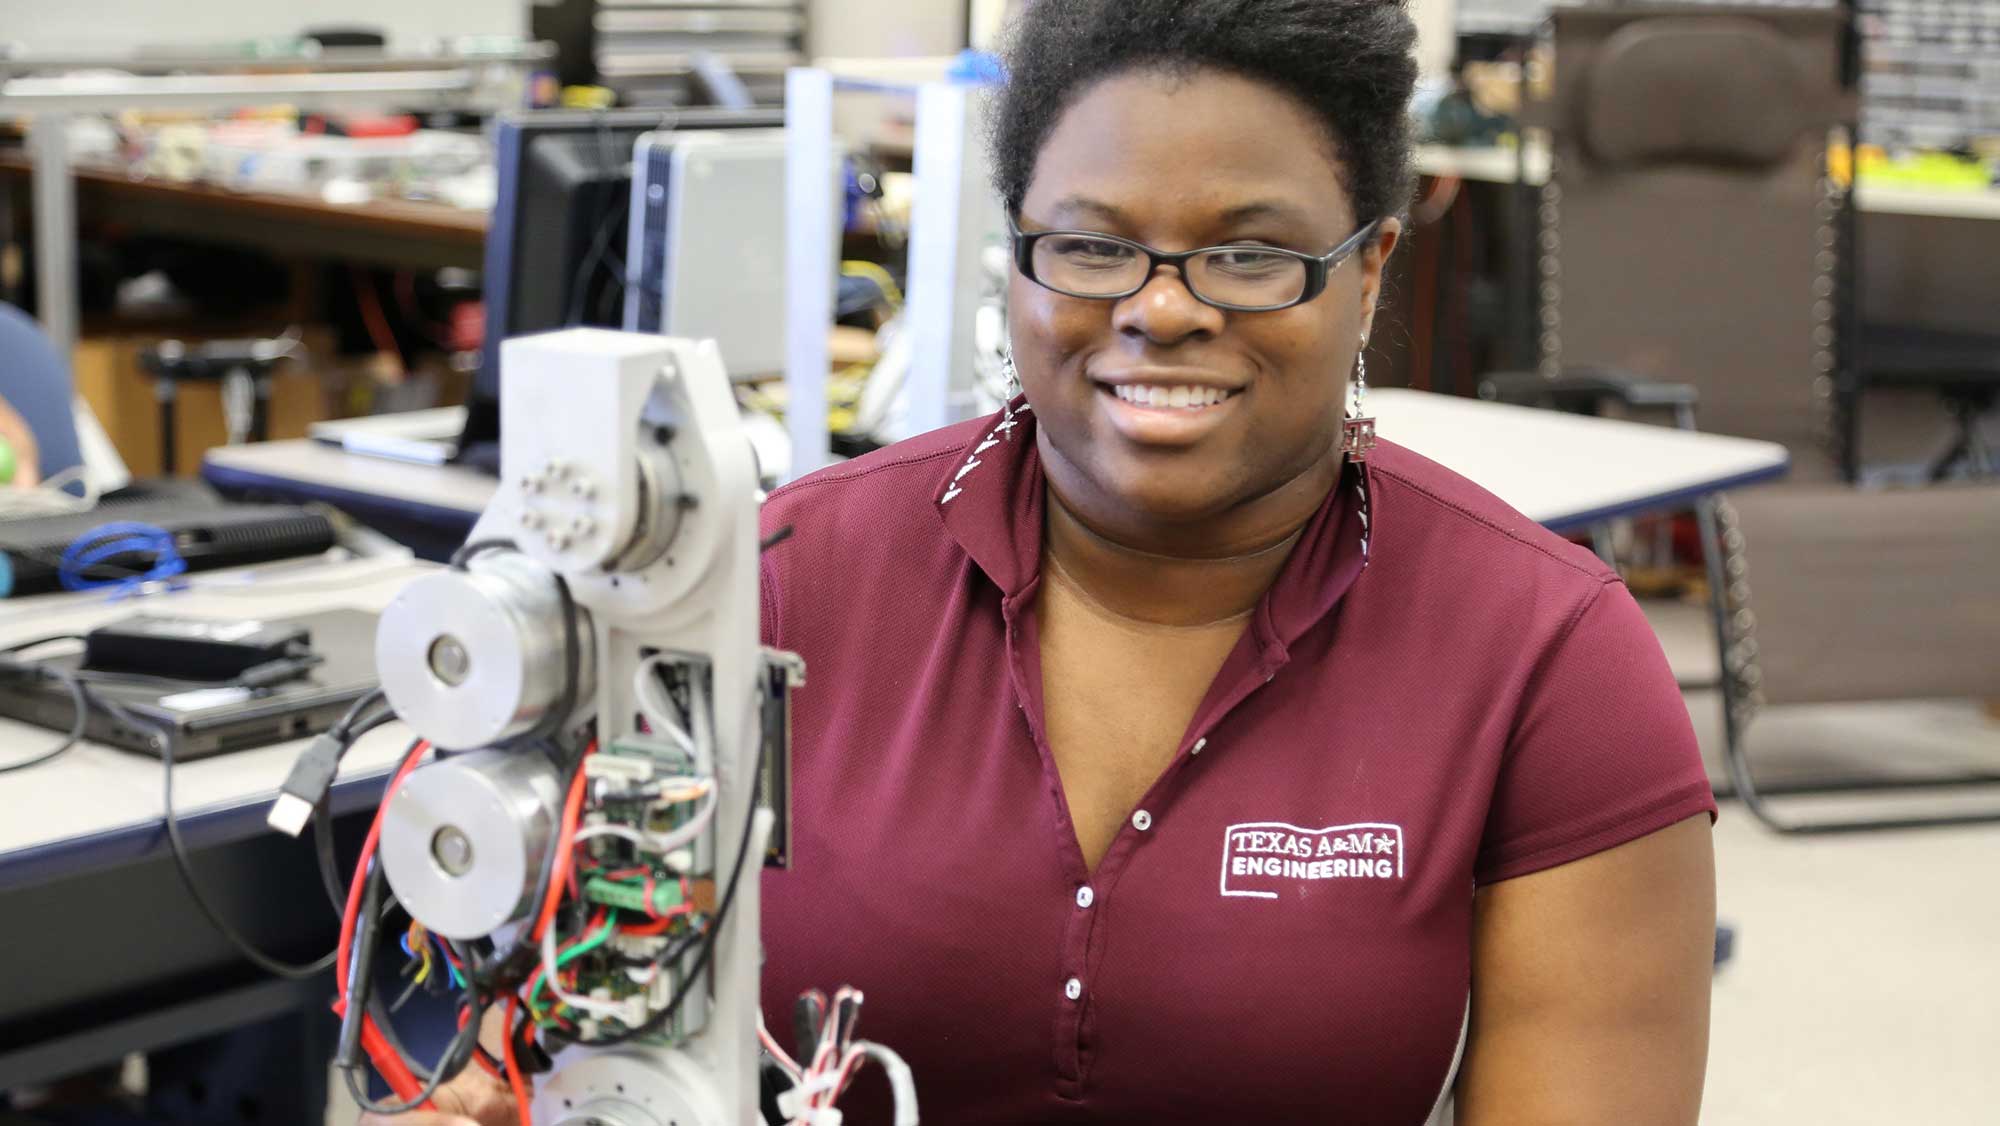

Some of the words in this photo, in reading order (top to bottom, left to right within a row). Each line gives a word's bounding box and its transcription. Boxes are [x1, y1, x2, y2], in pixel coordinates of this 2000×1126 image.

[1232, 831, 1311, 857] TEXAS
[1315, 833, 1373, 857] A&M
[1232, 857, 1393, 879] ENGINEERING
